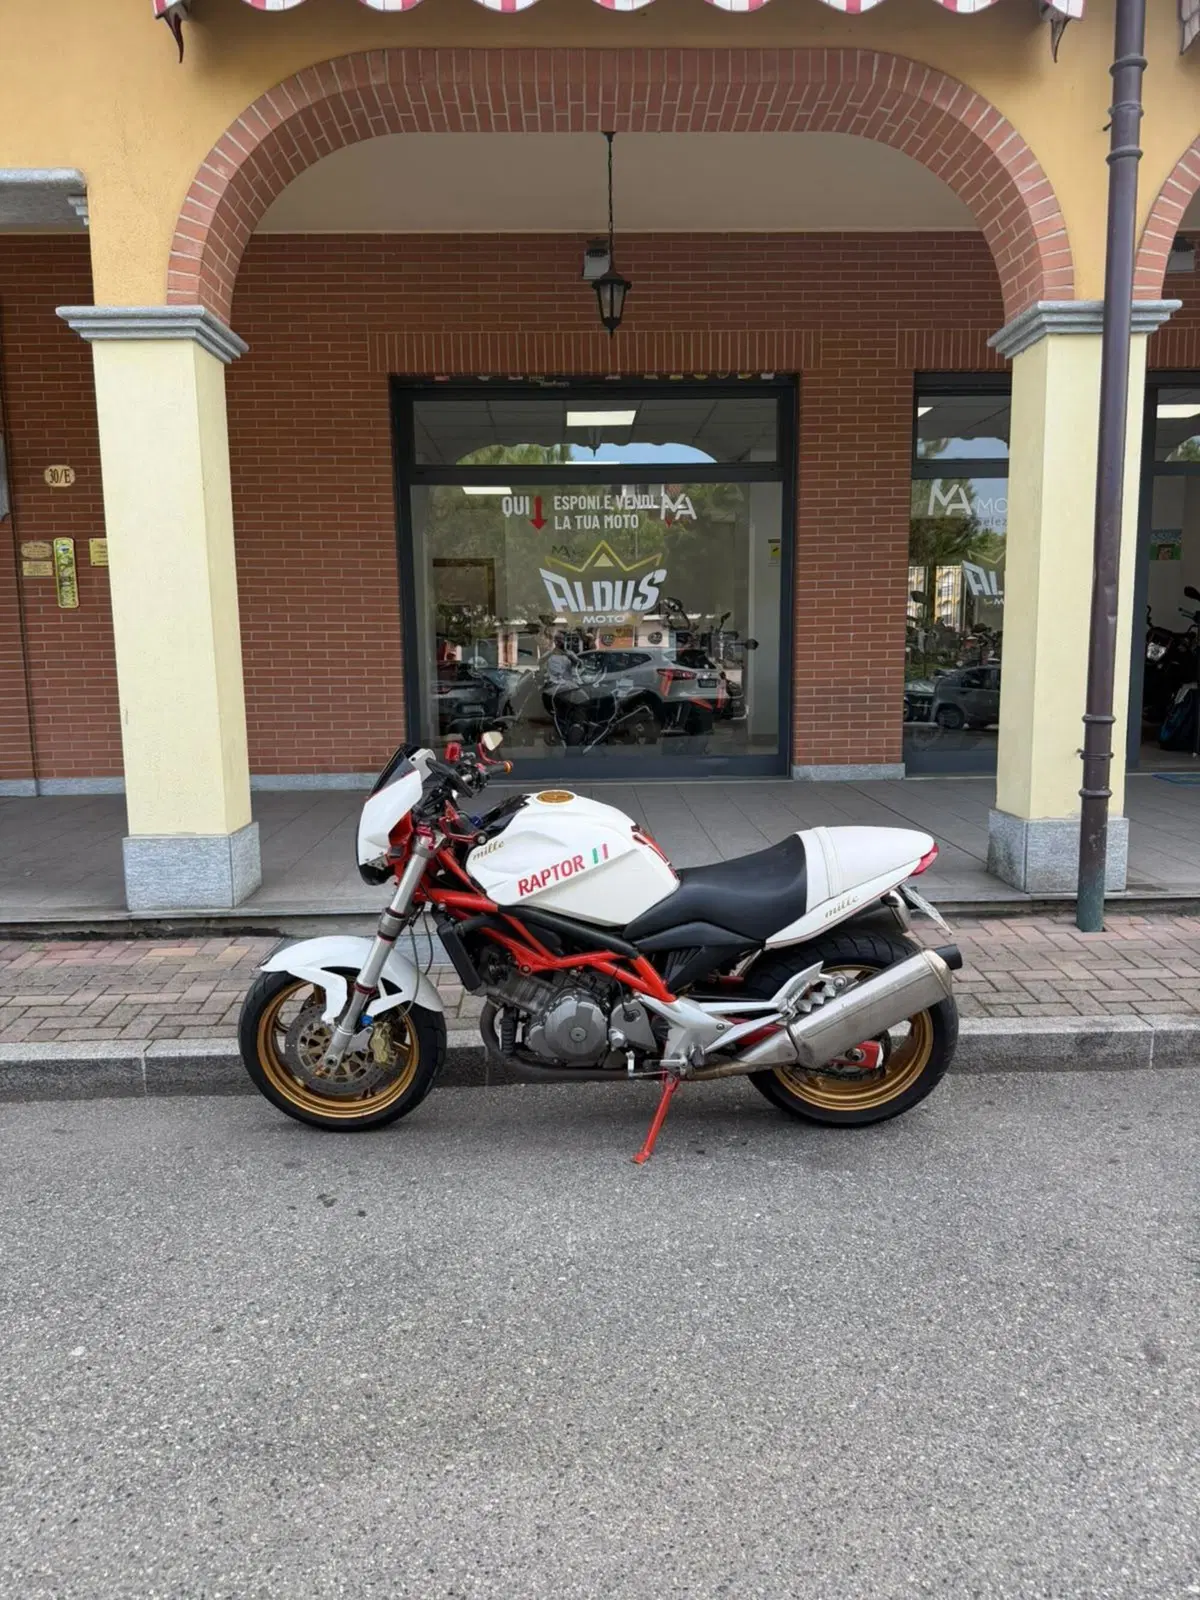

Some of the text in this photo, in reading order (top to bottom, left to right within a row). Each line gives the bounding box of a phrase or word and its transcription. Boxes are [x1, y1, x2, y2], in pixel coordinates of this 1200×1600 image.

[49, 468, 71, 484] 30/E
[501, 496, 529, 518] QUI
[554, 495, 657, 511] ESPONI E VENDI
[555, 514, 639, 530] LA TUA MOTO
[539, 568, 668, 613] ALDUS
[582, 614, 626, 624] MOTO
[472, 840, 505, 861] mille
[517, 854, 586, 896] RAPTOR
[824, 895, 859, 919] mille
